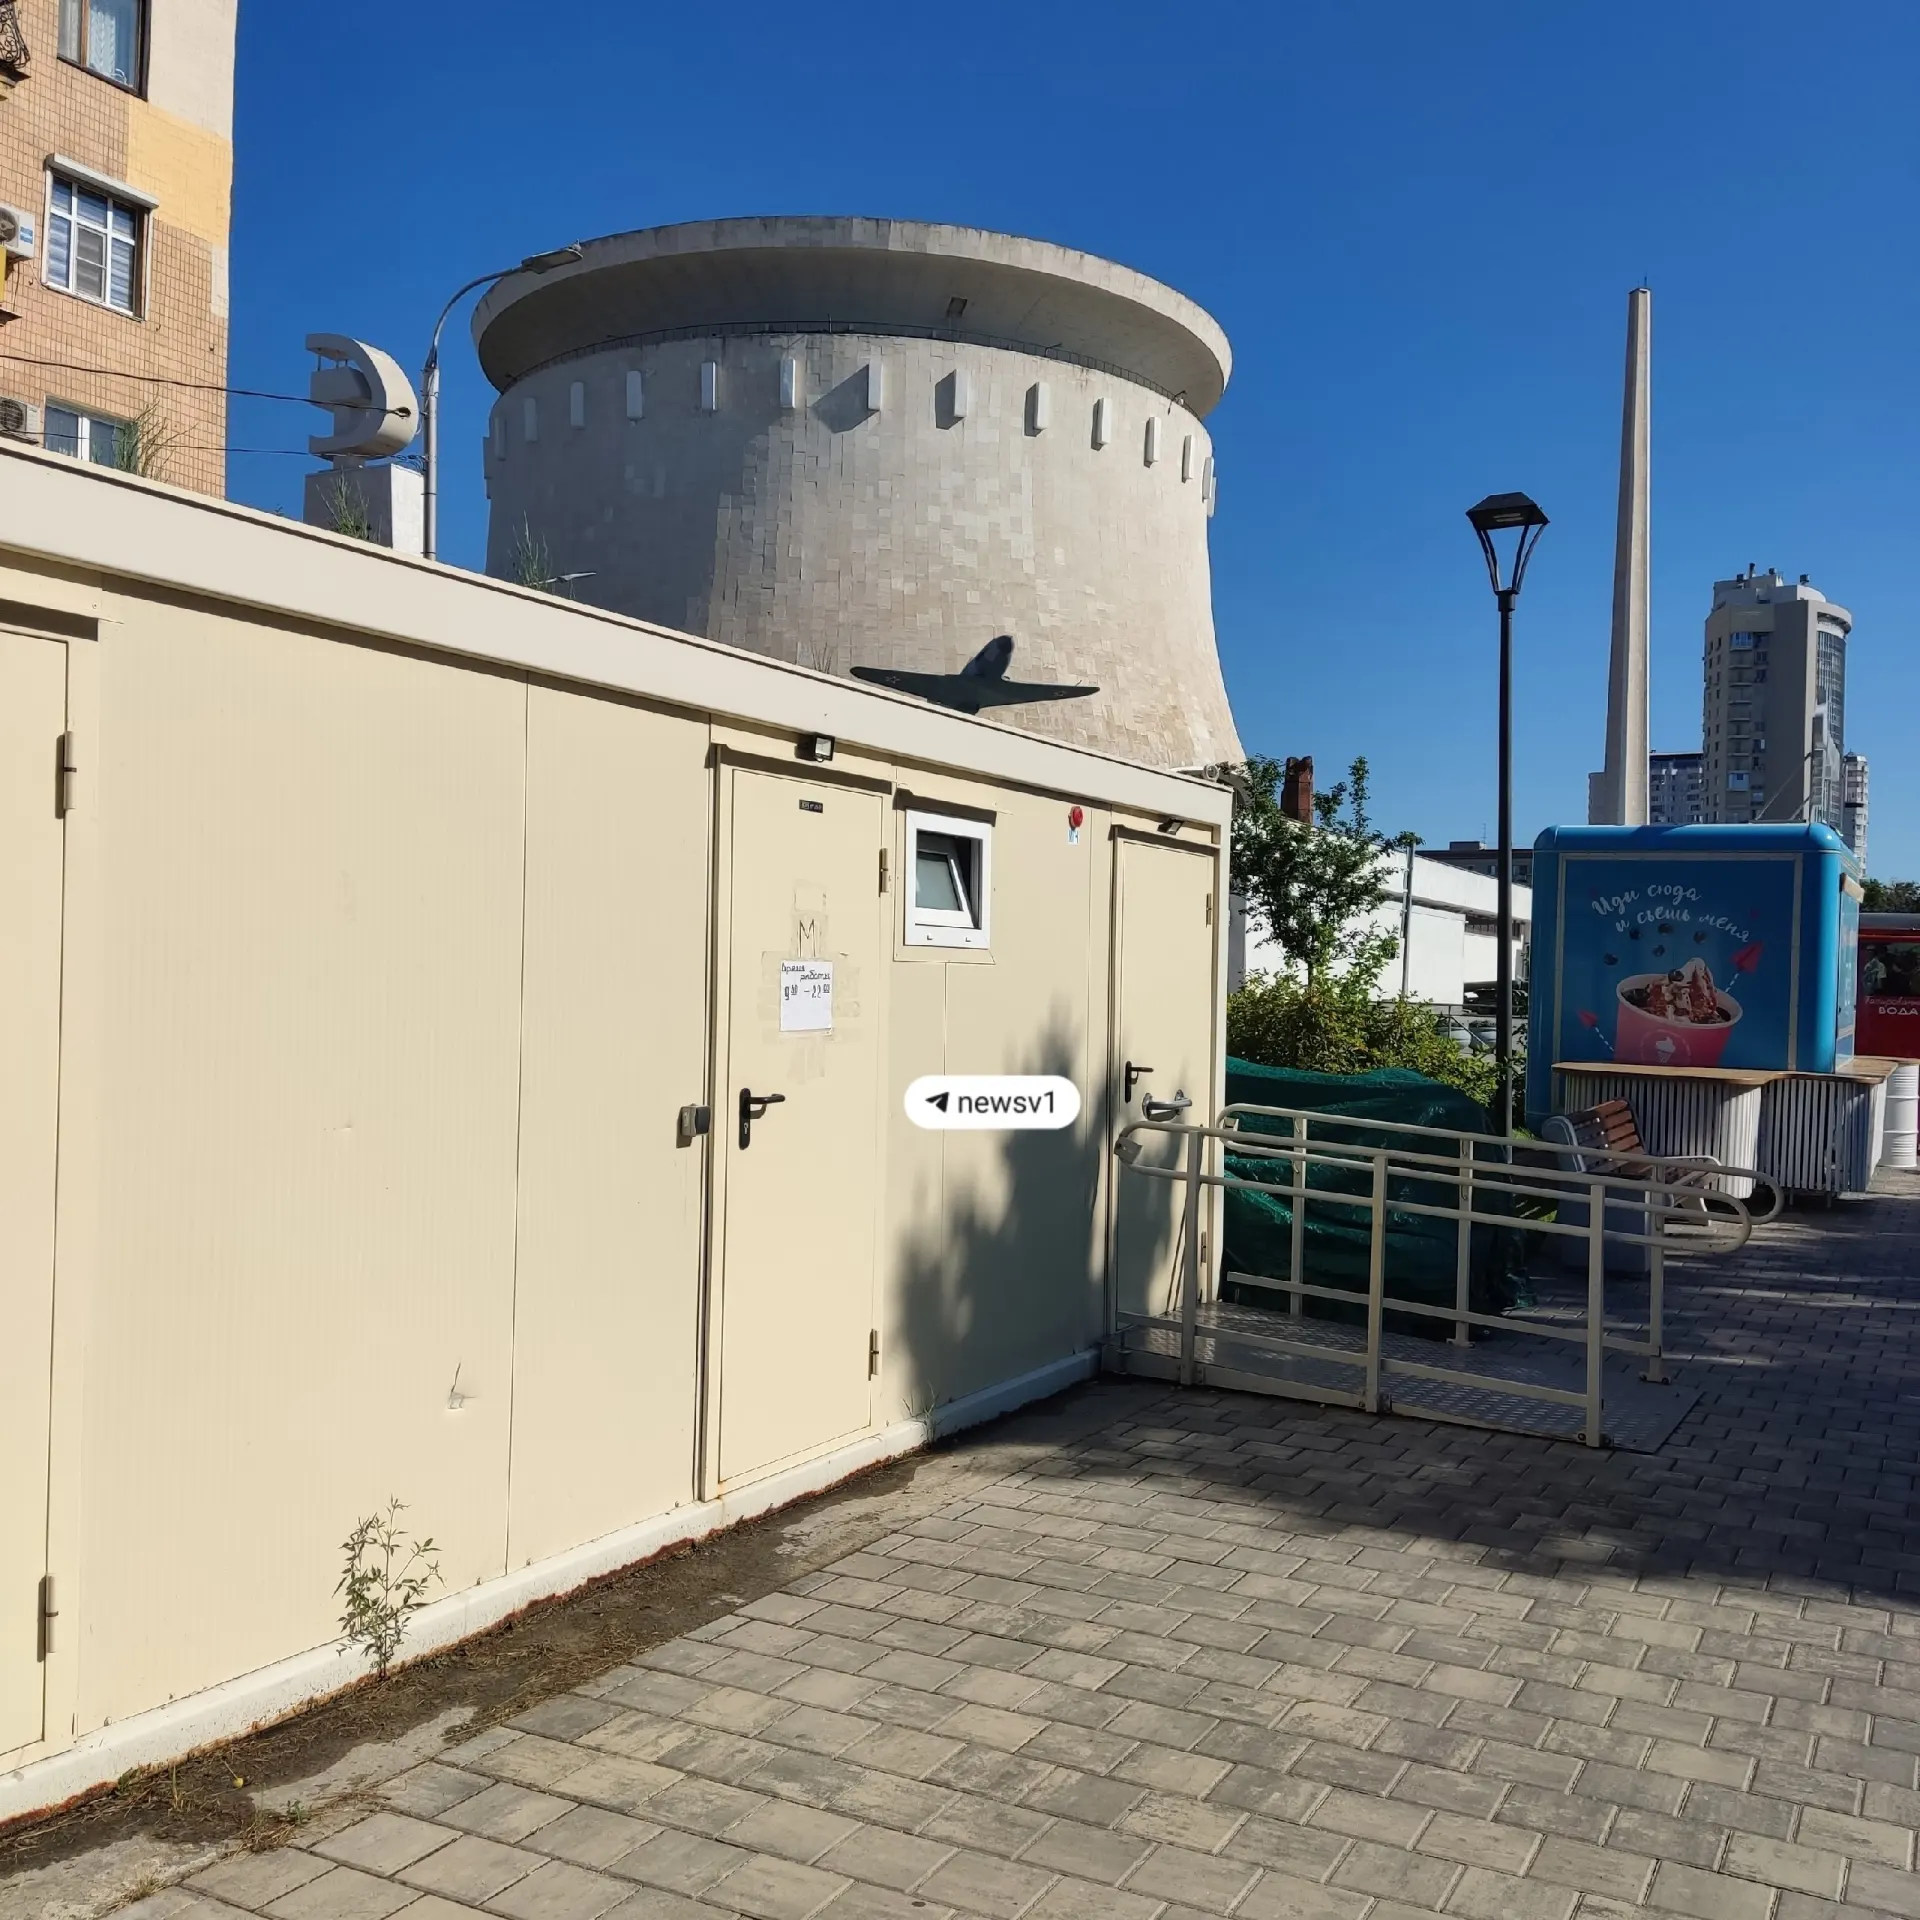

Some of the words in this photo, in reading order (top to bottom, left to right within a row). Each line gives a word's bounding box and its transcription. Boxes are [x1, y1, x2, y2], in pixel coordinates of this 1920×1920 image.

[1592, 890, 1640, 916] Иди
[1647, 884, 1702, 906] сюда
[1615, 919, 1630, 933] и
[1699, 914, 1751, 943] меня
[1878, 1006, 1919, 1016] ВОДА
